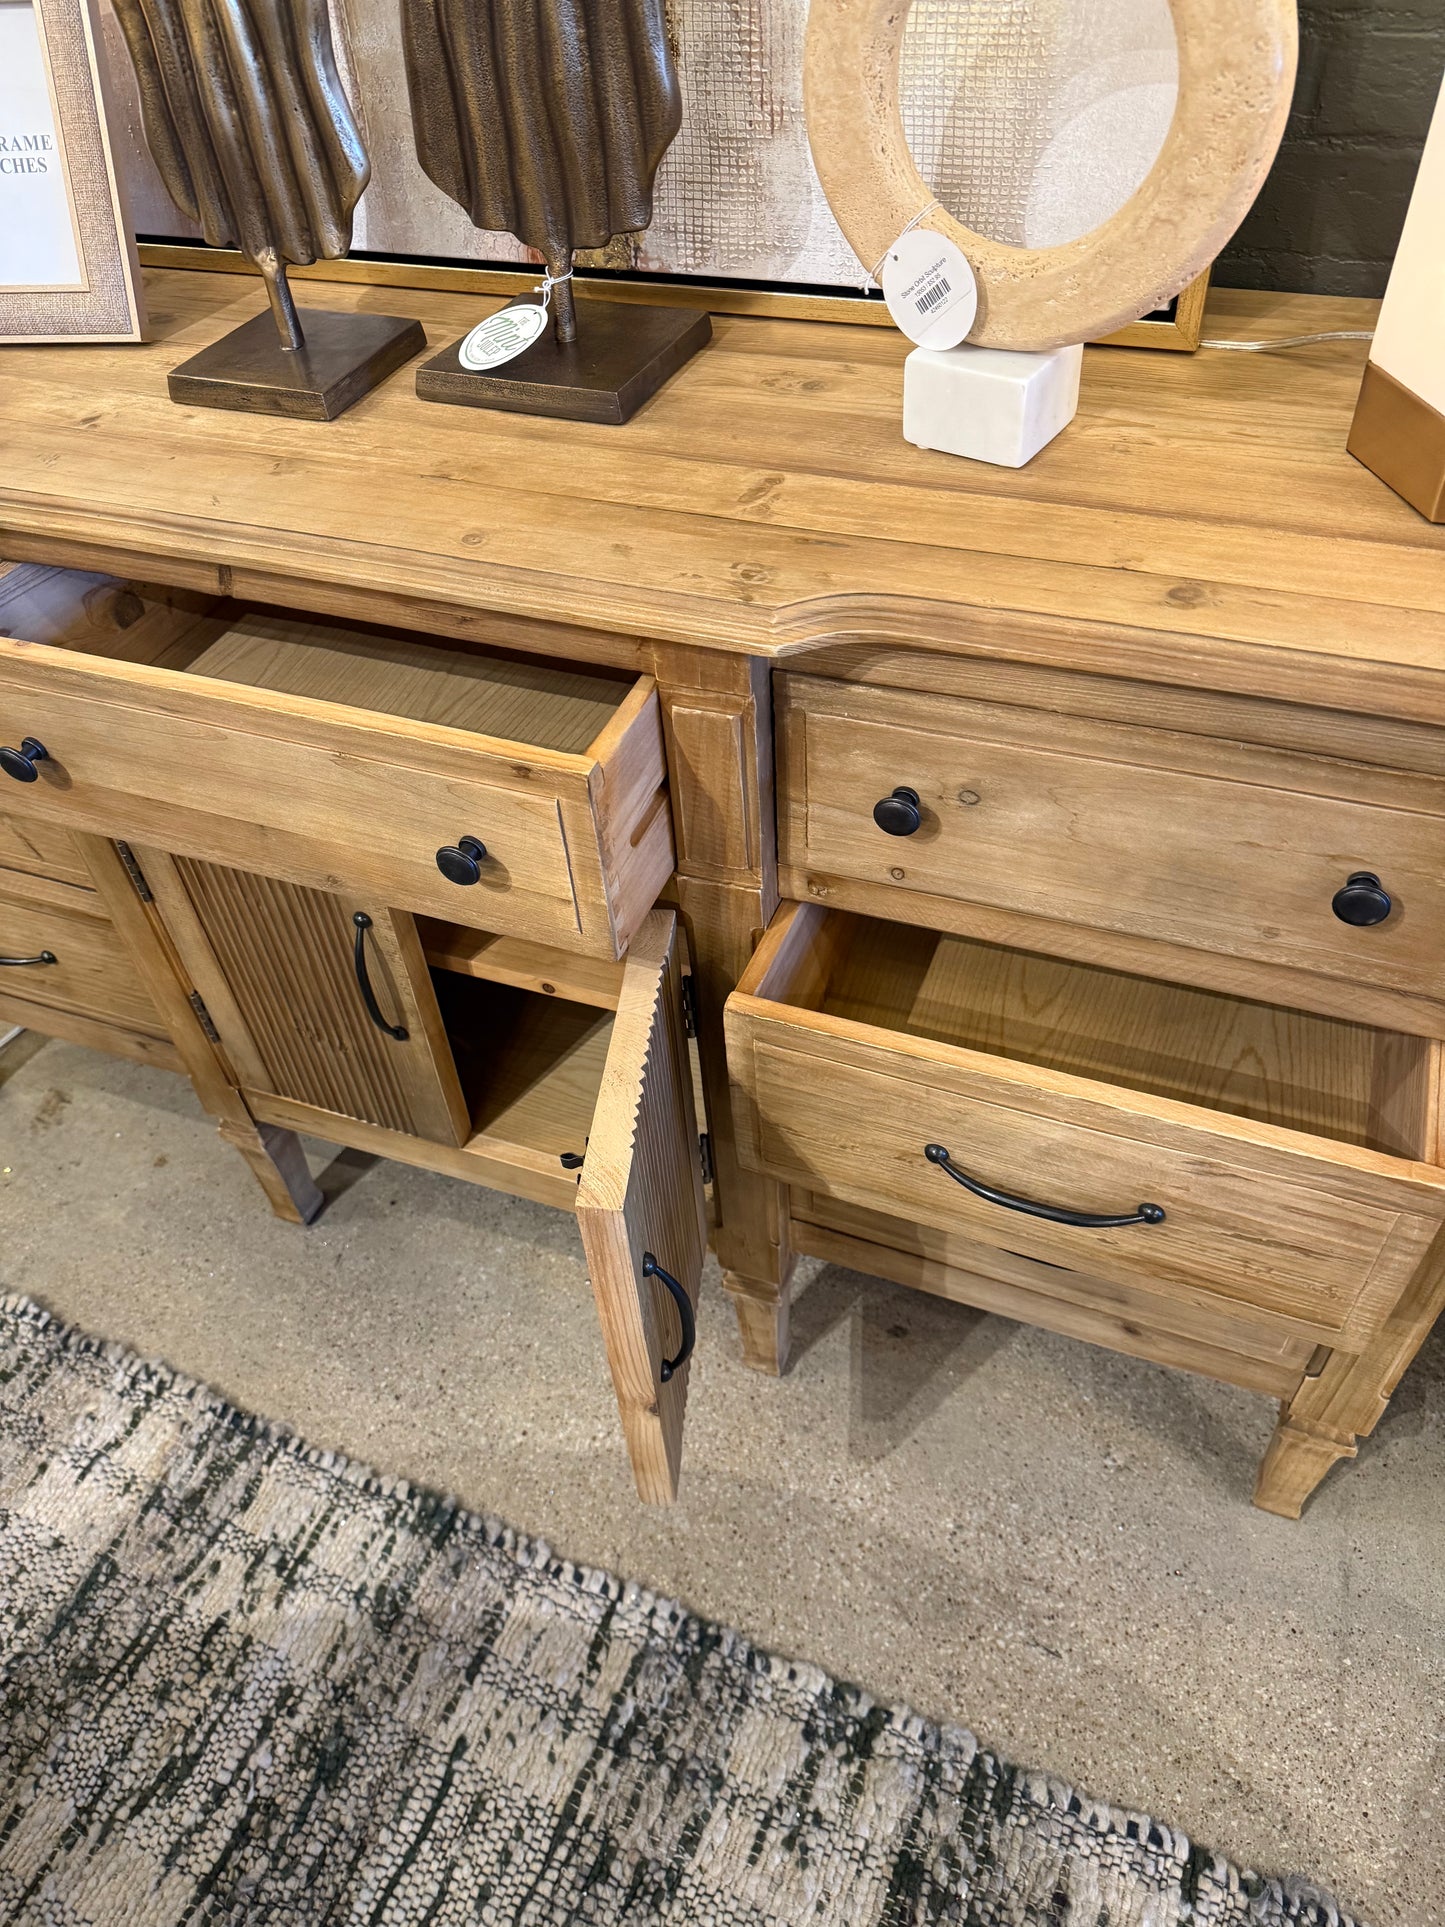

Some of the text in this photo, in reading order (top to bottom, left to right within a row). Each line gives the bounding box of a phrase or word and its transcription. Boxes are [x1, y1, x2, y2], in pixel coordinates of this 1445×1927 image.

[0, 135, 53, 152] RAME
[0, 157, 48, 174] CHES
[901, 257, 946, 299] Stone Orbit Sculpture
[480, 316, 535, 350] Mint
[476, 339, 501, 356] JULEP
